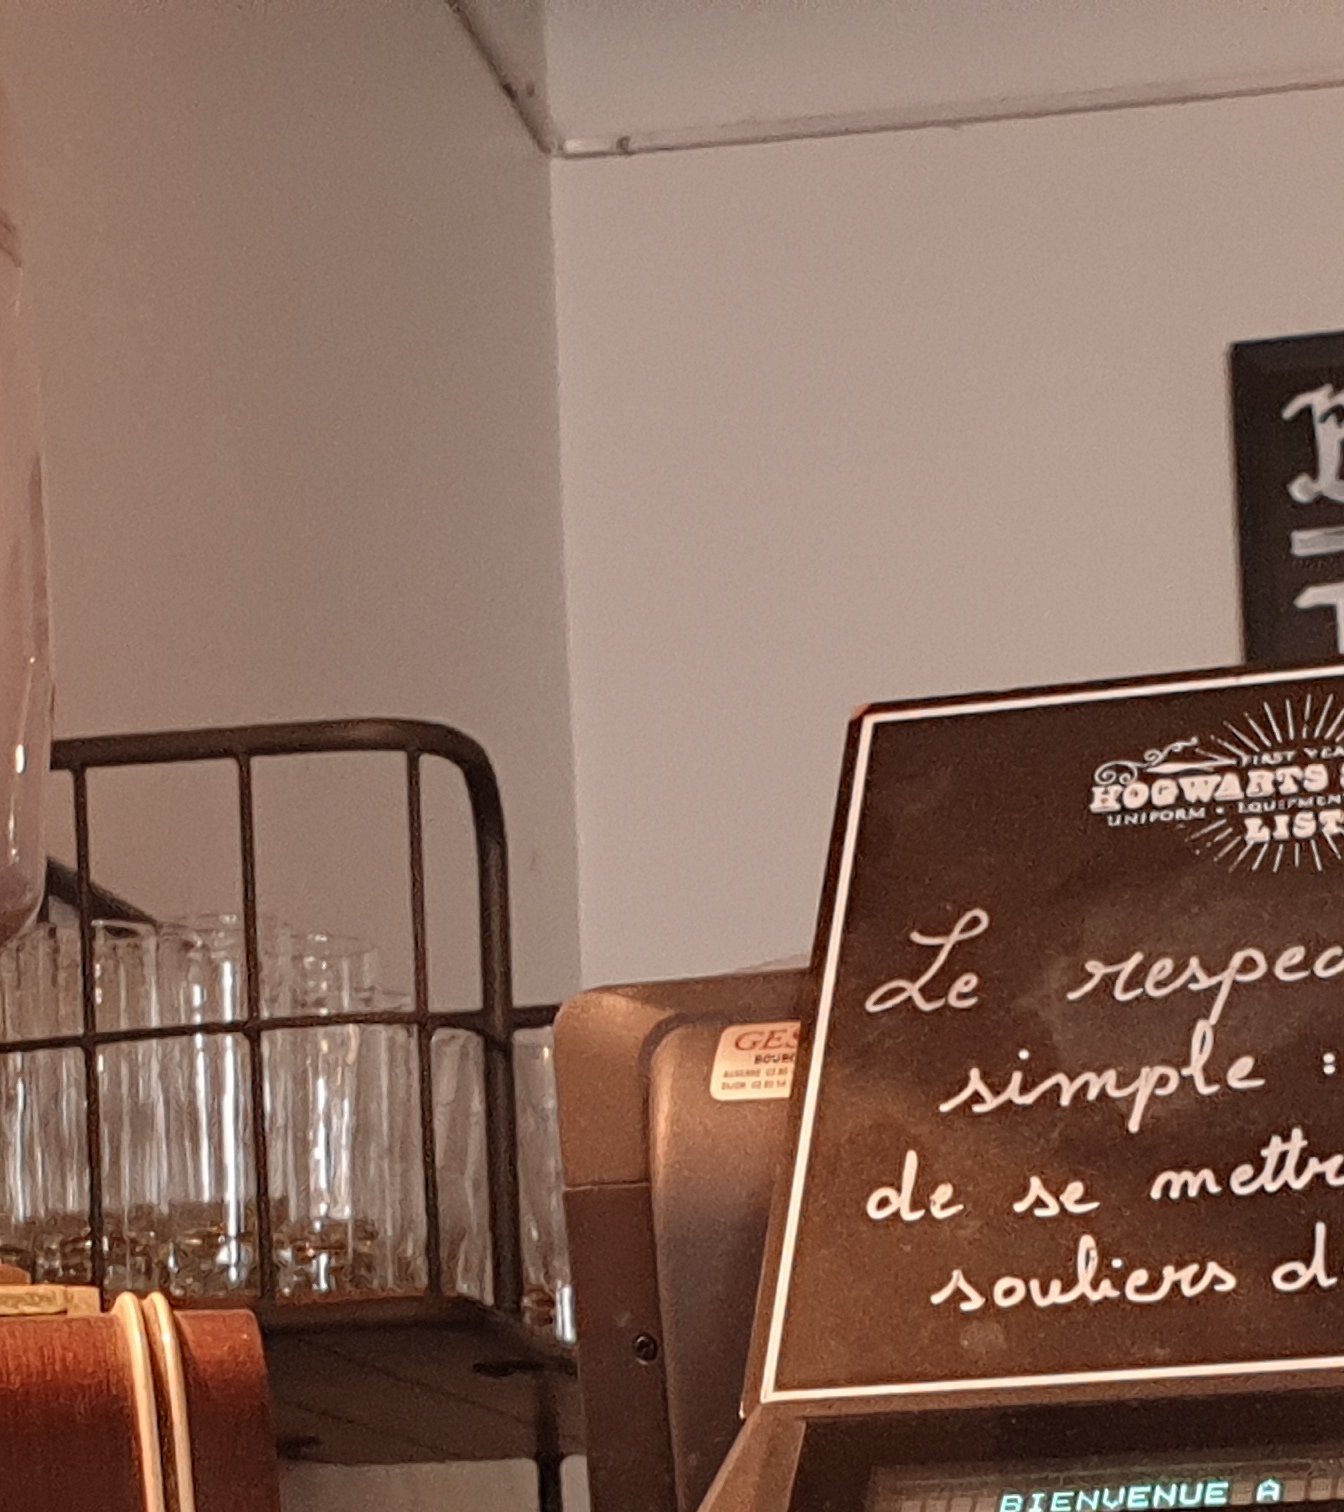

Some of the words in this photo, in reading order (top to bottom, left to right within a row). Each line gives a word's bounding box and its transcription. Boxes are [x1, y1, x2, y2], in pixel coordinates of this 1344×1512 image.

[1089, 762, 1330, 813] HOGWARTS
[1107, 806, 1206, 828] UNIFORM
[865, 908, 990, 1014] Le
[938, 1018, 1266, 1133] simple
[865, 1149, 965, 1224] de
[1013, 1168, 1100, 1219] se
[929, 1233, 1238, 1313] souliers
[1255, 1477, 1284, 1504] A
